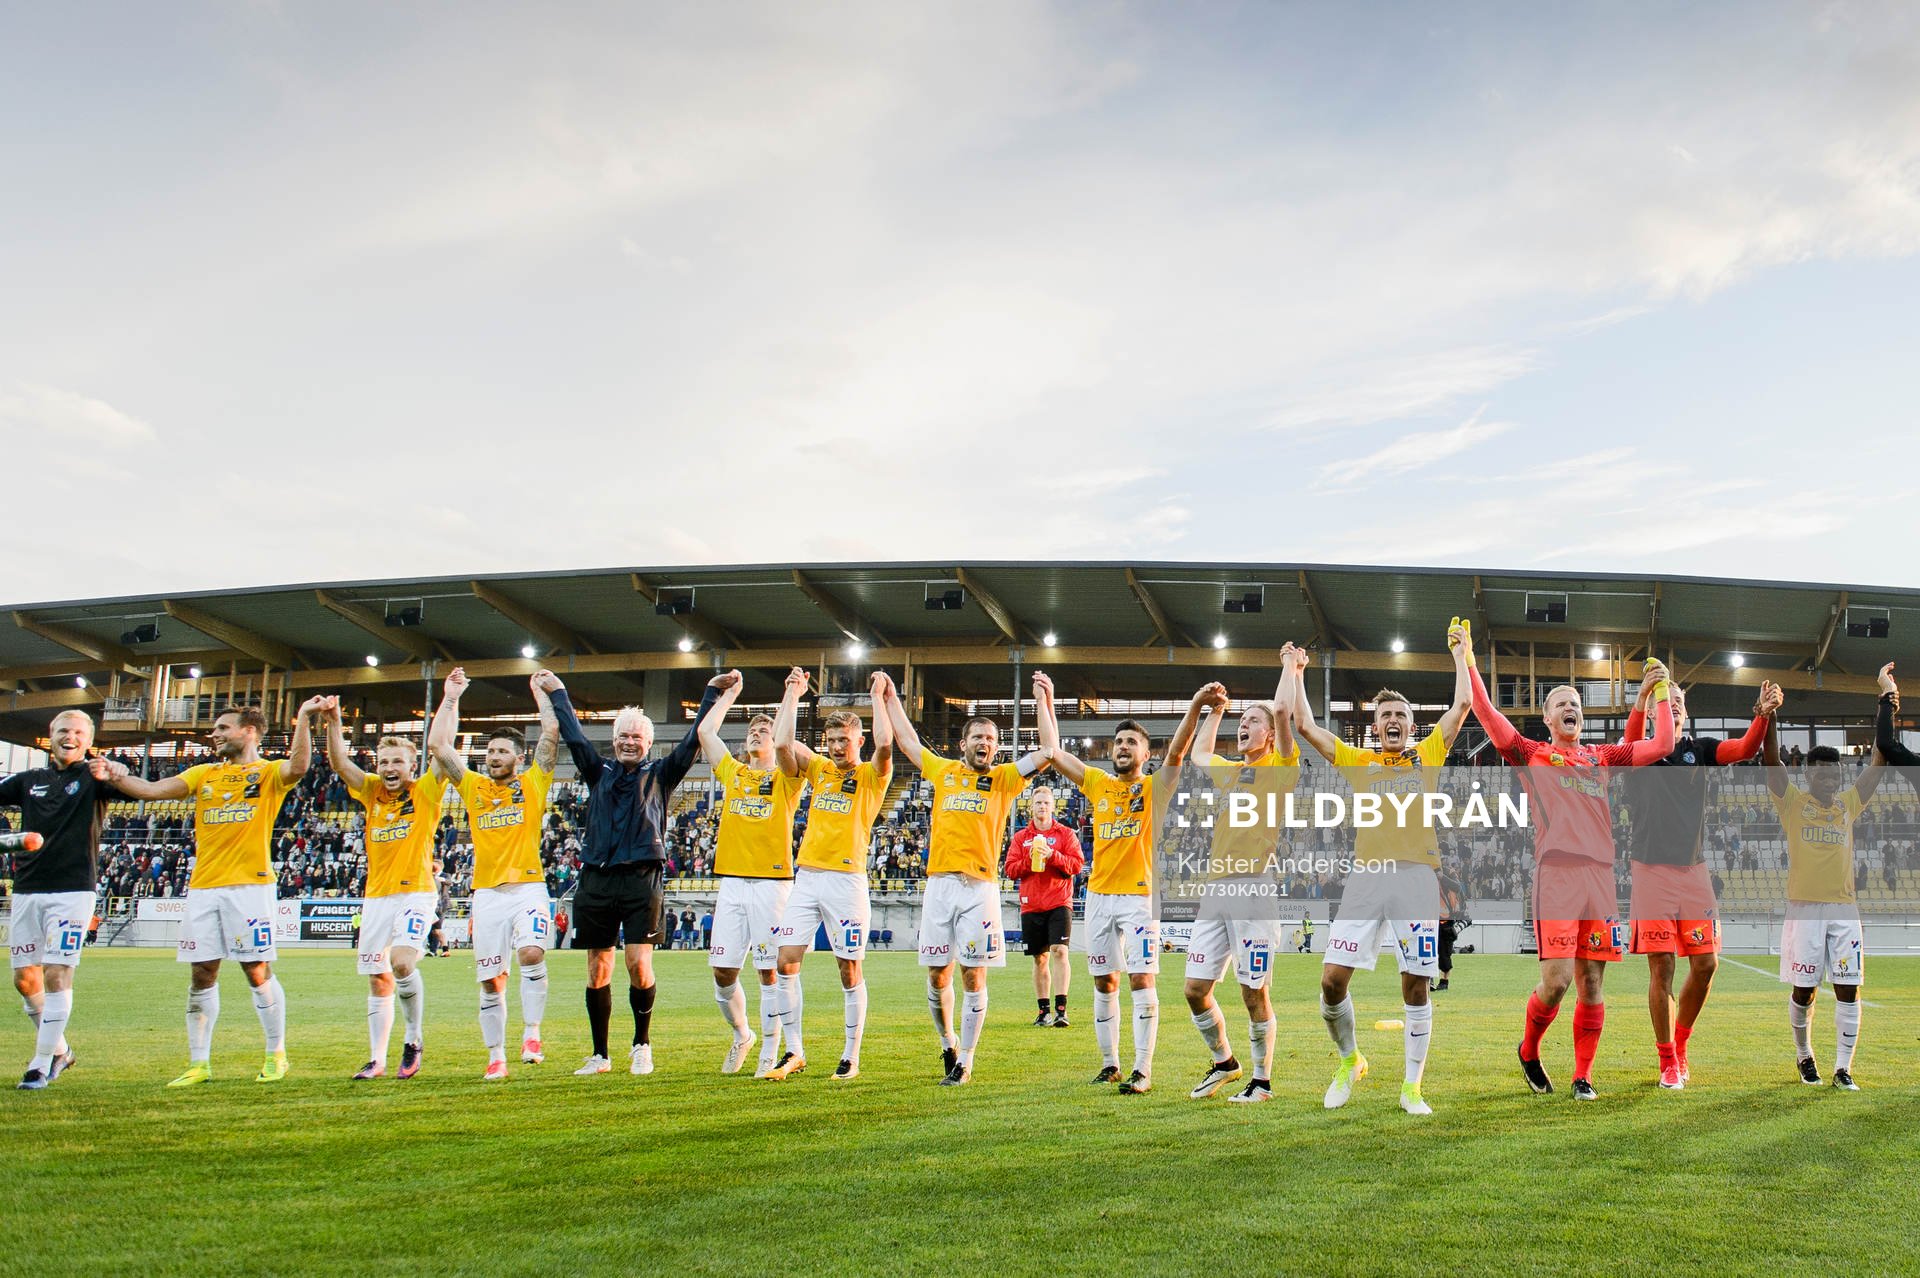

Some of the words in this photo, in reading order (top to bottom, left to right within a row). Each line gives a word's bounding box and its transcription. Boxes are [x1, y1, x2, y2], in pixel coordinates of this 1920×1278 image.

[1163, 906, 1194, 914] motions
[310, 922, 353, 932] HUSCENT
[921, 944, 950, 955] V-TAB
